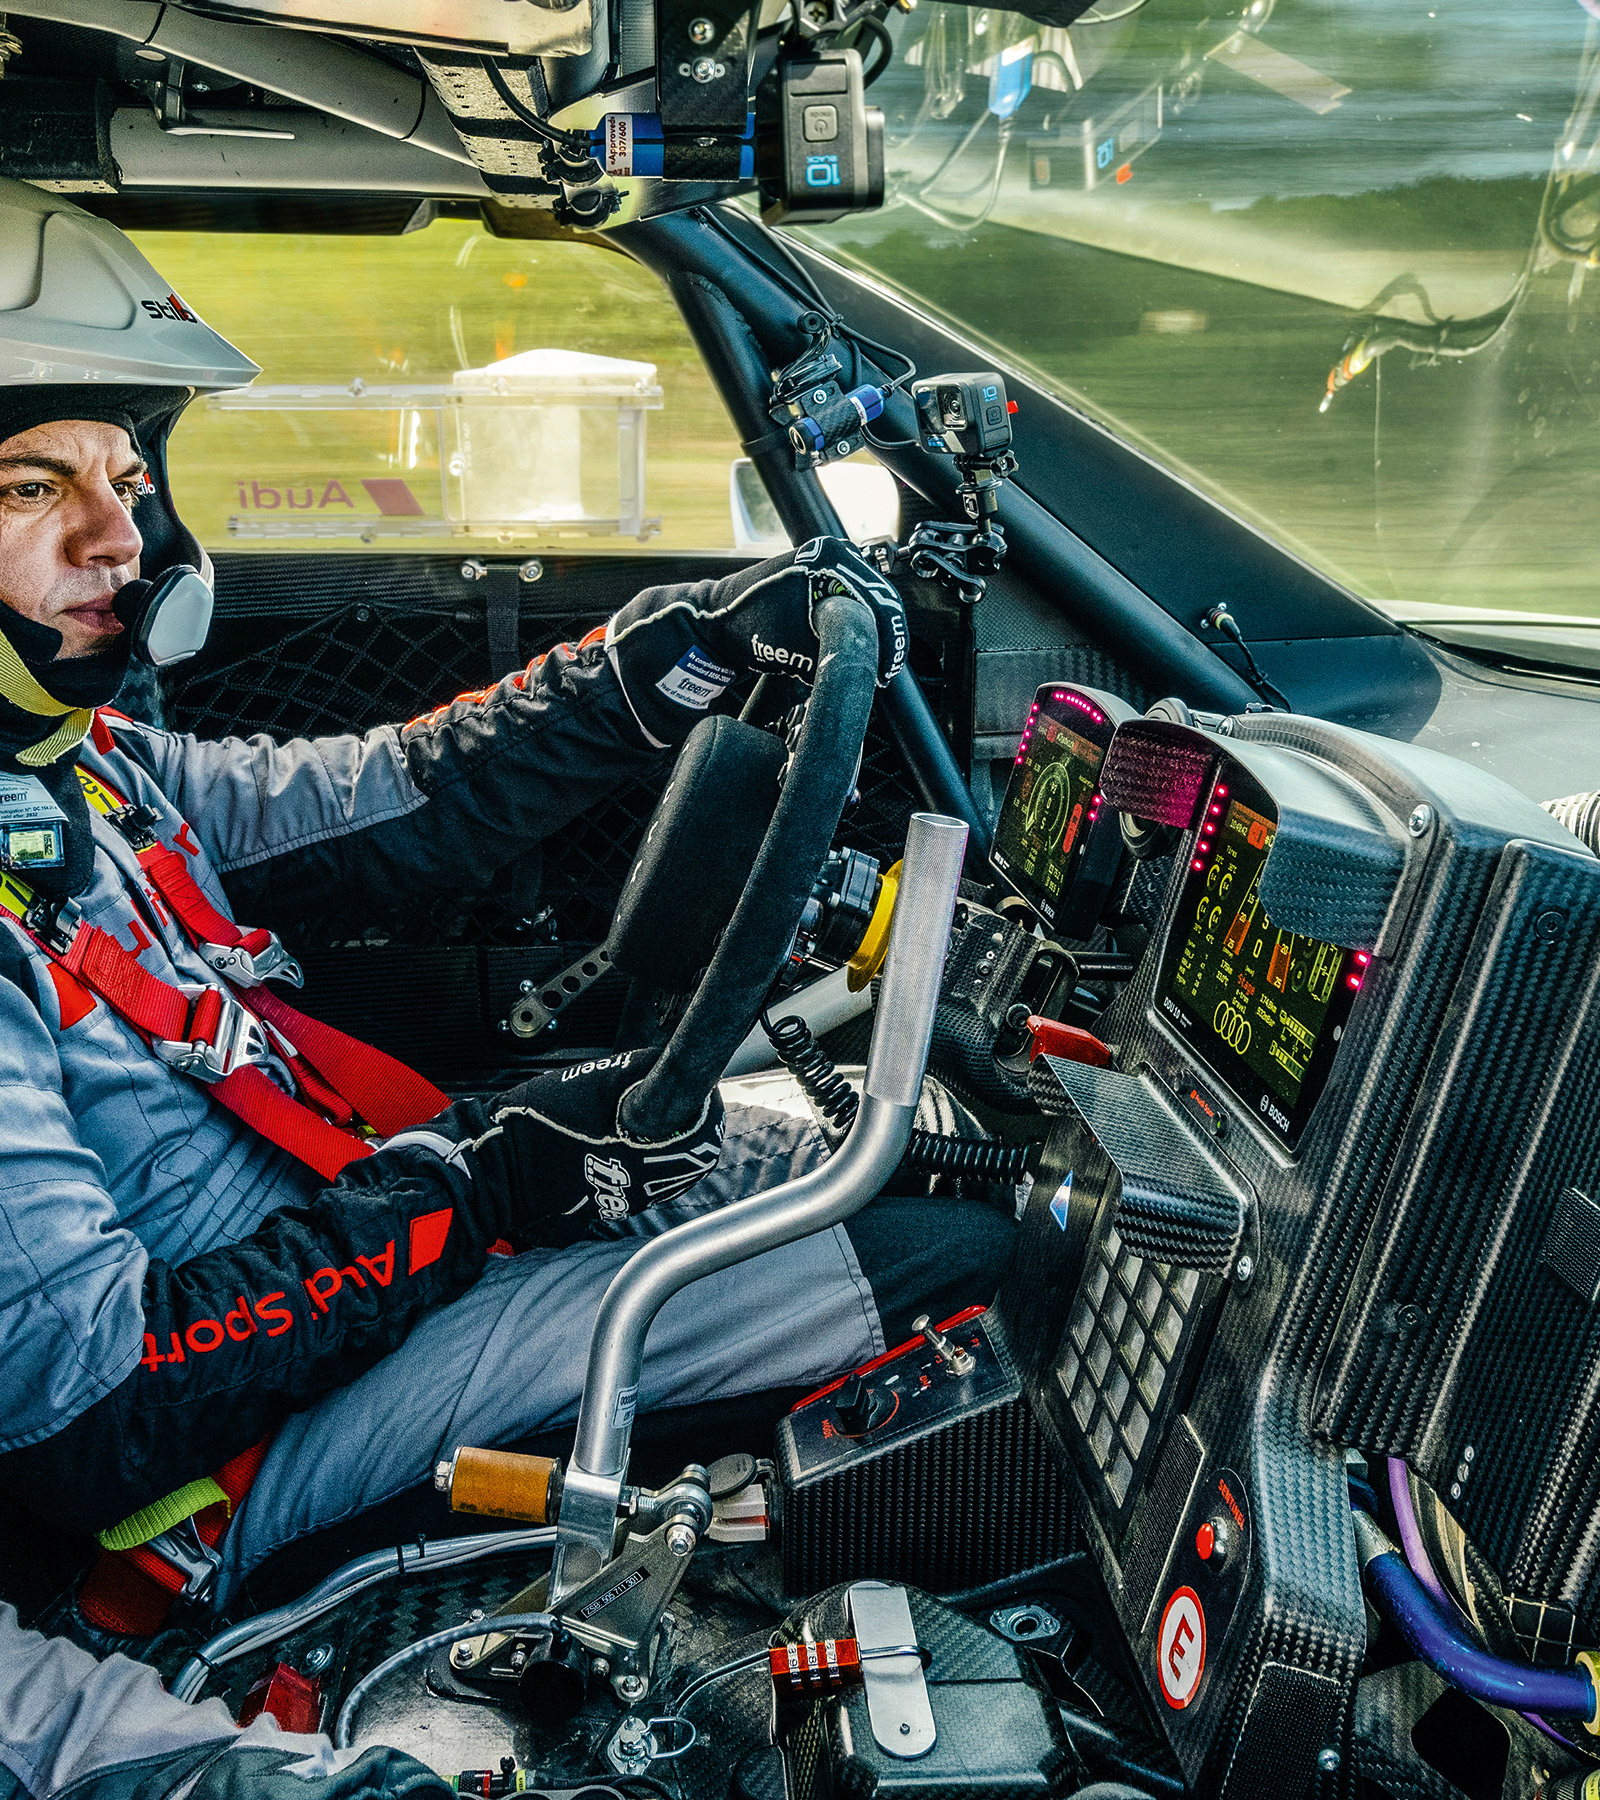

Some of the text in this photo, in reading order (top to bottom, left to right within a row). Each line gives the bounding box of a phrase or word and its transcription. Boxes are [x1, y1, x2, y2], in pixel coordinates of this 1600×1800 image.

[618, 121, 627, 157] 307/600
[806, 163, 840, 186] 10
[141, 293, 198, 323] Stilo
[751, 634, 813, 672] freem
[885, 615, 905, 679] freem
[678, 677, 714, 698] freem
[561, 1051, 633, 1083] freem
[1267, 1103, 1291, 1132] BOSCH
[140, 1239, 396, 1372] Audi Sport
[1168, 1613, 1195, 1682] E
